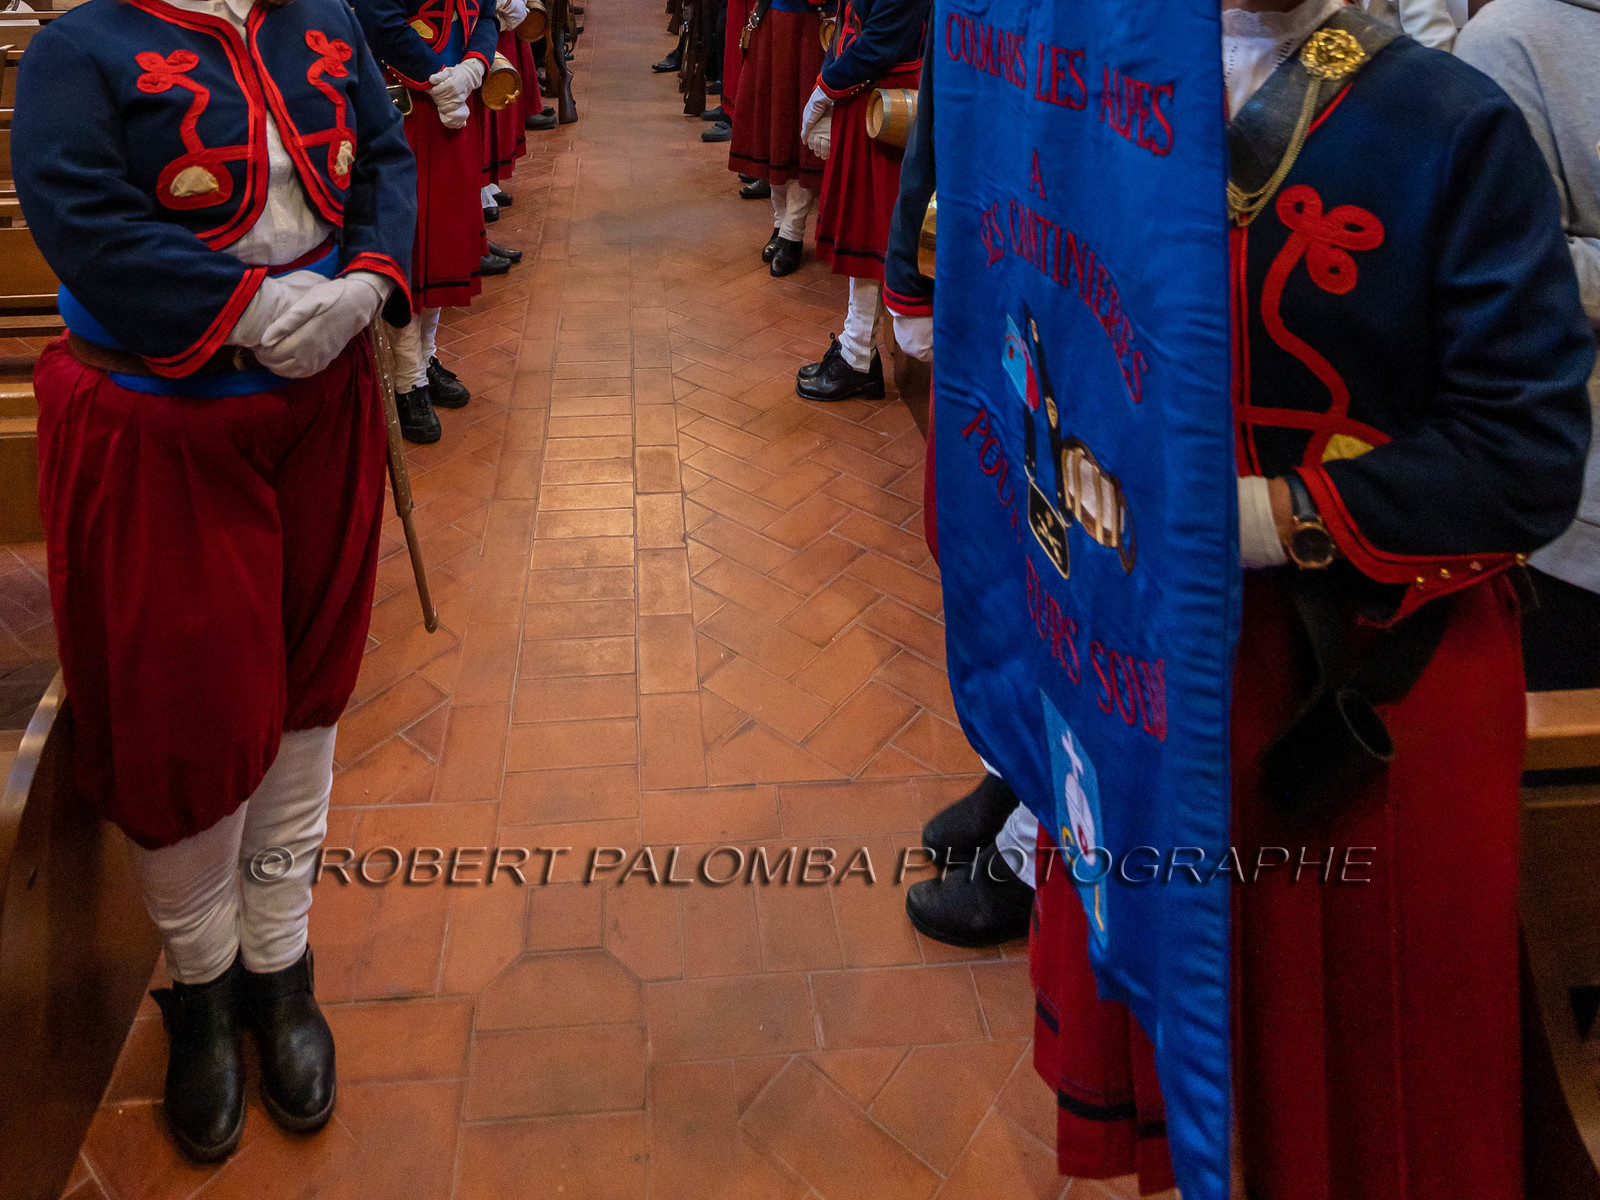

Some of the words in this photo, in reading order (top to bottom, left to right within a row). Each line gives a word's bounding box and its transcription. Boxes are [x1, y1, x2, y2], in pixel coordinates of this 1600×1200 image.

[946, 13, 1026, 89] COLMARS
[1035, 42, 1087, 111] LES
[1099, 64, 1174, 157] ALPES
[1030, 149, 1046, 199] A
